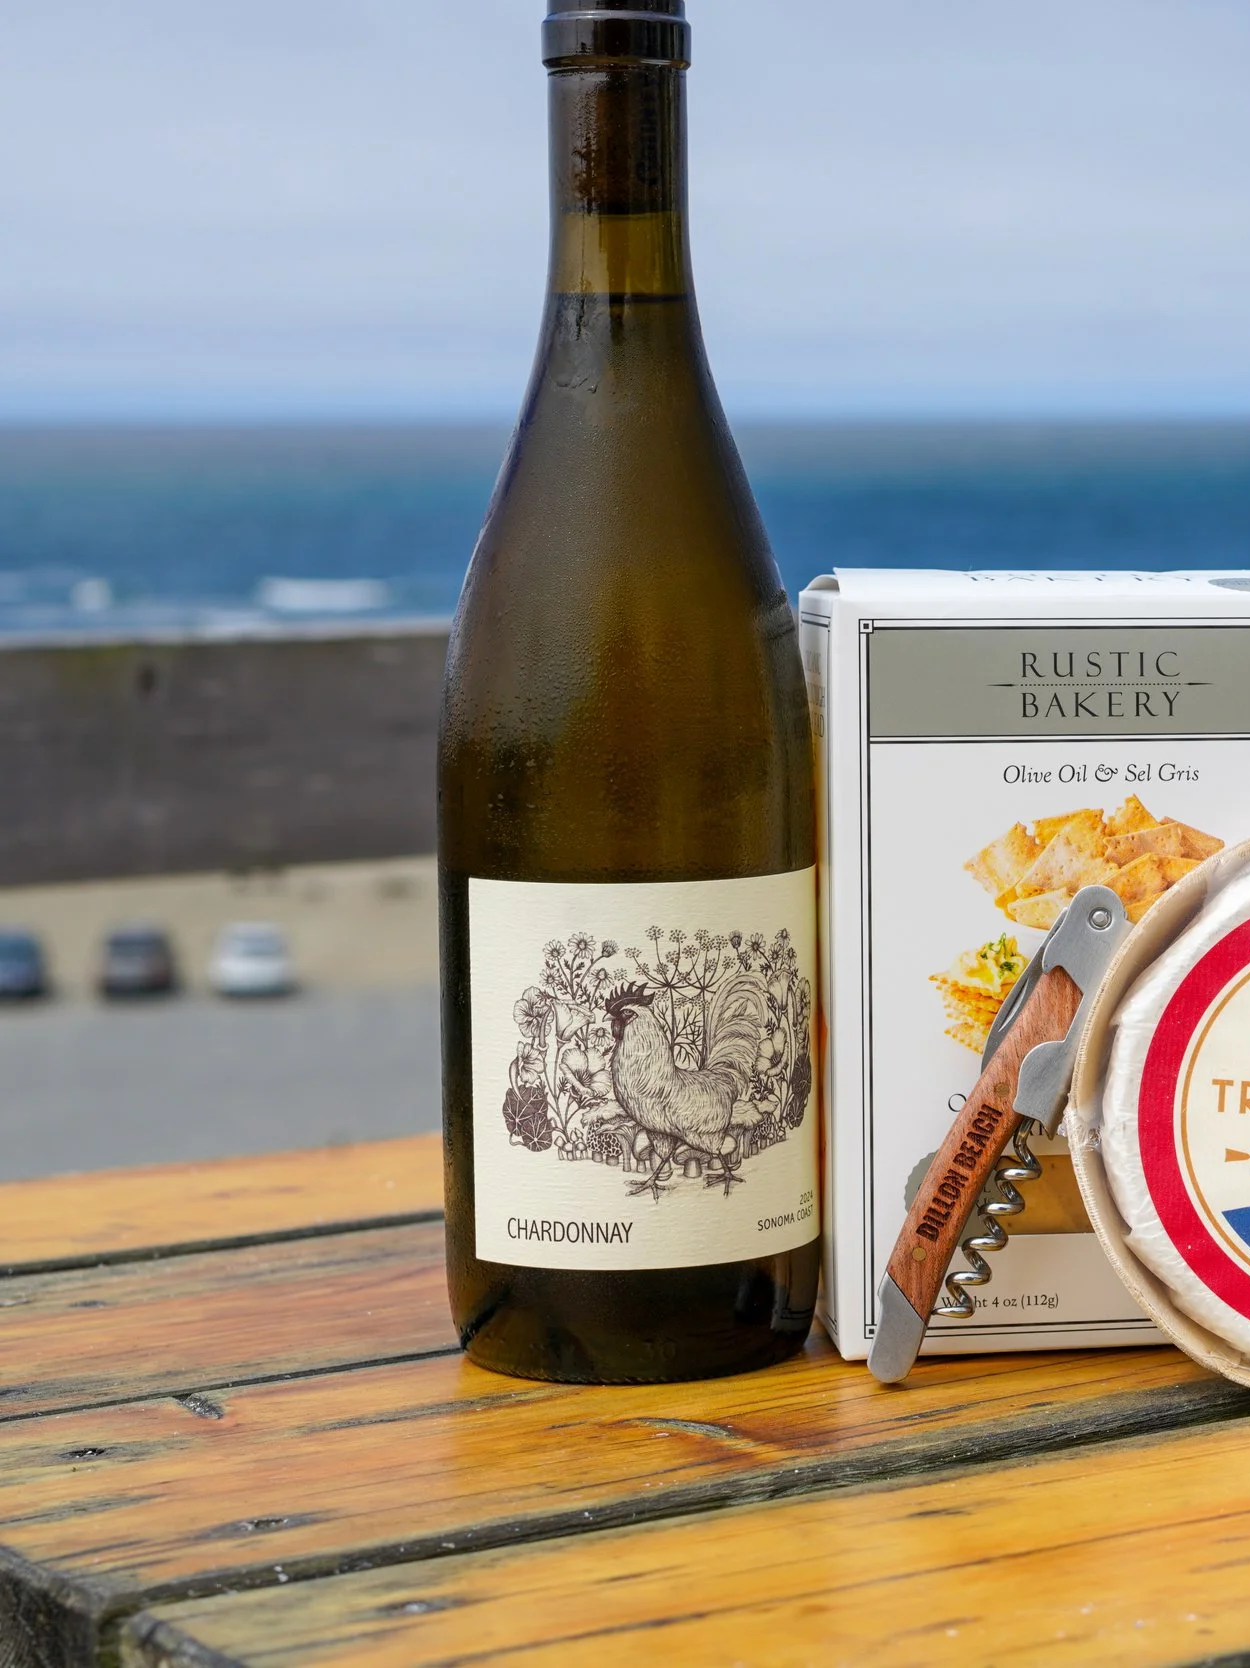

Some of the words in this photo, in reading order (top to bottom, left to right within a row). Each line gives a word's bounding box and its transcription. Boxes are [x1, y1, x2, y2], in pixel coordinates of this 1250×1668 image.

[1021, 651, 1181, 678] RUSTIC
[1021, 691, 1181, 718] BAKERY
[1003, 765, 1052, 784] Olive
[1058, 764, 1087, 783] Oil
[1094, 763, 1119, 783] &
[1124, 763, 1152, 782] Sel
[1158, 763, 1200, 782] Gris
[915, 1168, 969, 1243] DILLON
[952, 1103, 1003, 1171] BEACH
[507, 1217, 633, 1244] CHARDONNAY
[757, 1212, 796, 1232] SONOMA
[797, 1204, 814, 1221] COAST
[992, 1297, 1000, 1308] 4
[1003, 1299, 1018, 1307] oz
[1021, 1294, 1059, 1309] (112g)
